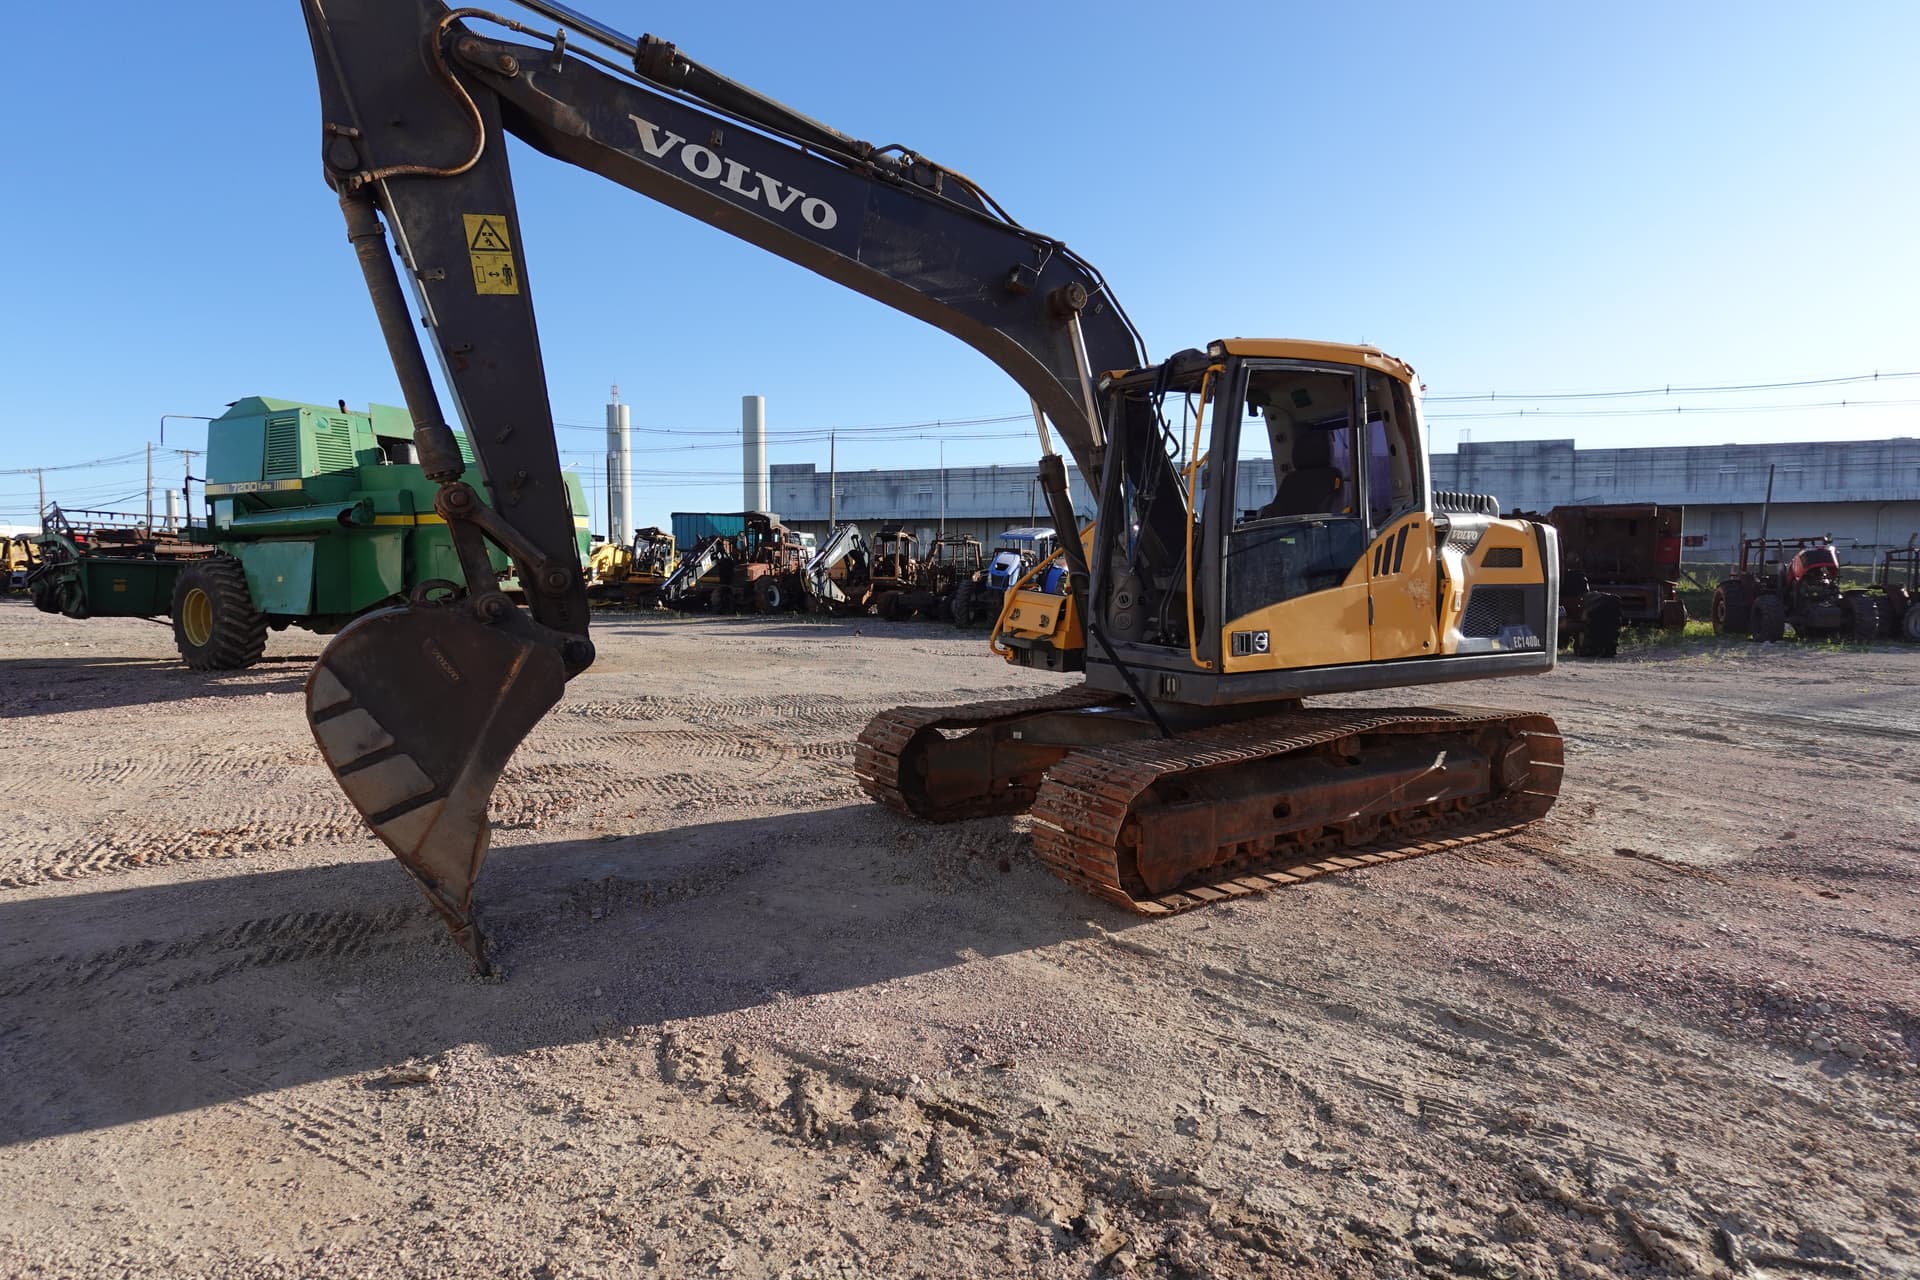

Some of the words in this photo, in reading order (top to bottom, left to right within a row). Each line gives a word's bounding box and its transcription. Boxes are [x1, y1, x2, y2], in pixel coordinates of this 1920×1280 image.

[628, 113, 838, 230] VOLVO
[231, 482, 257, 493] 7200
[1451, 530, 1478, 540] VOLVO
